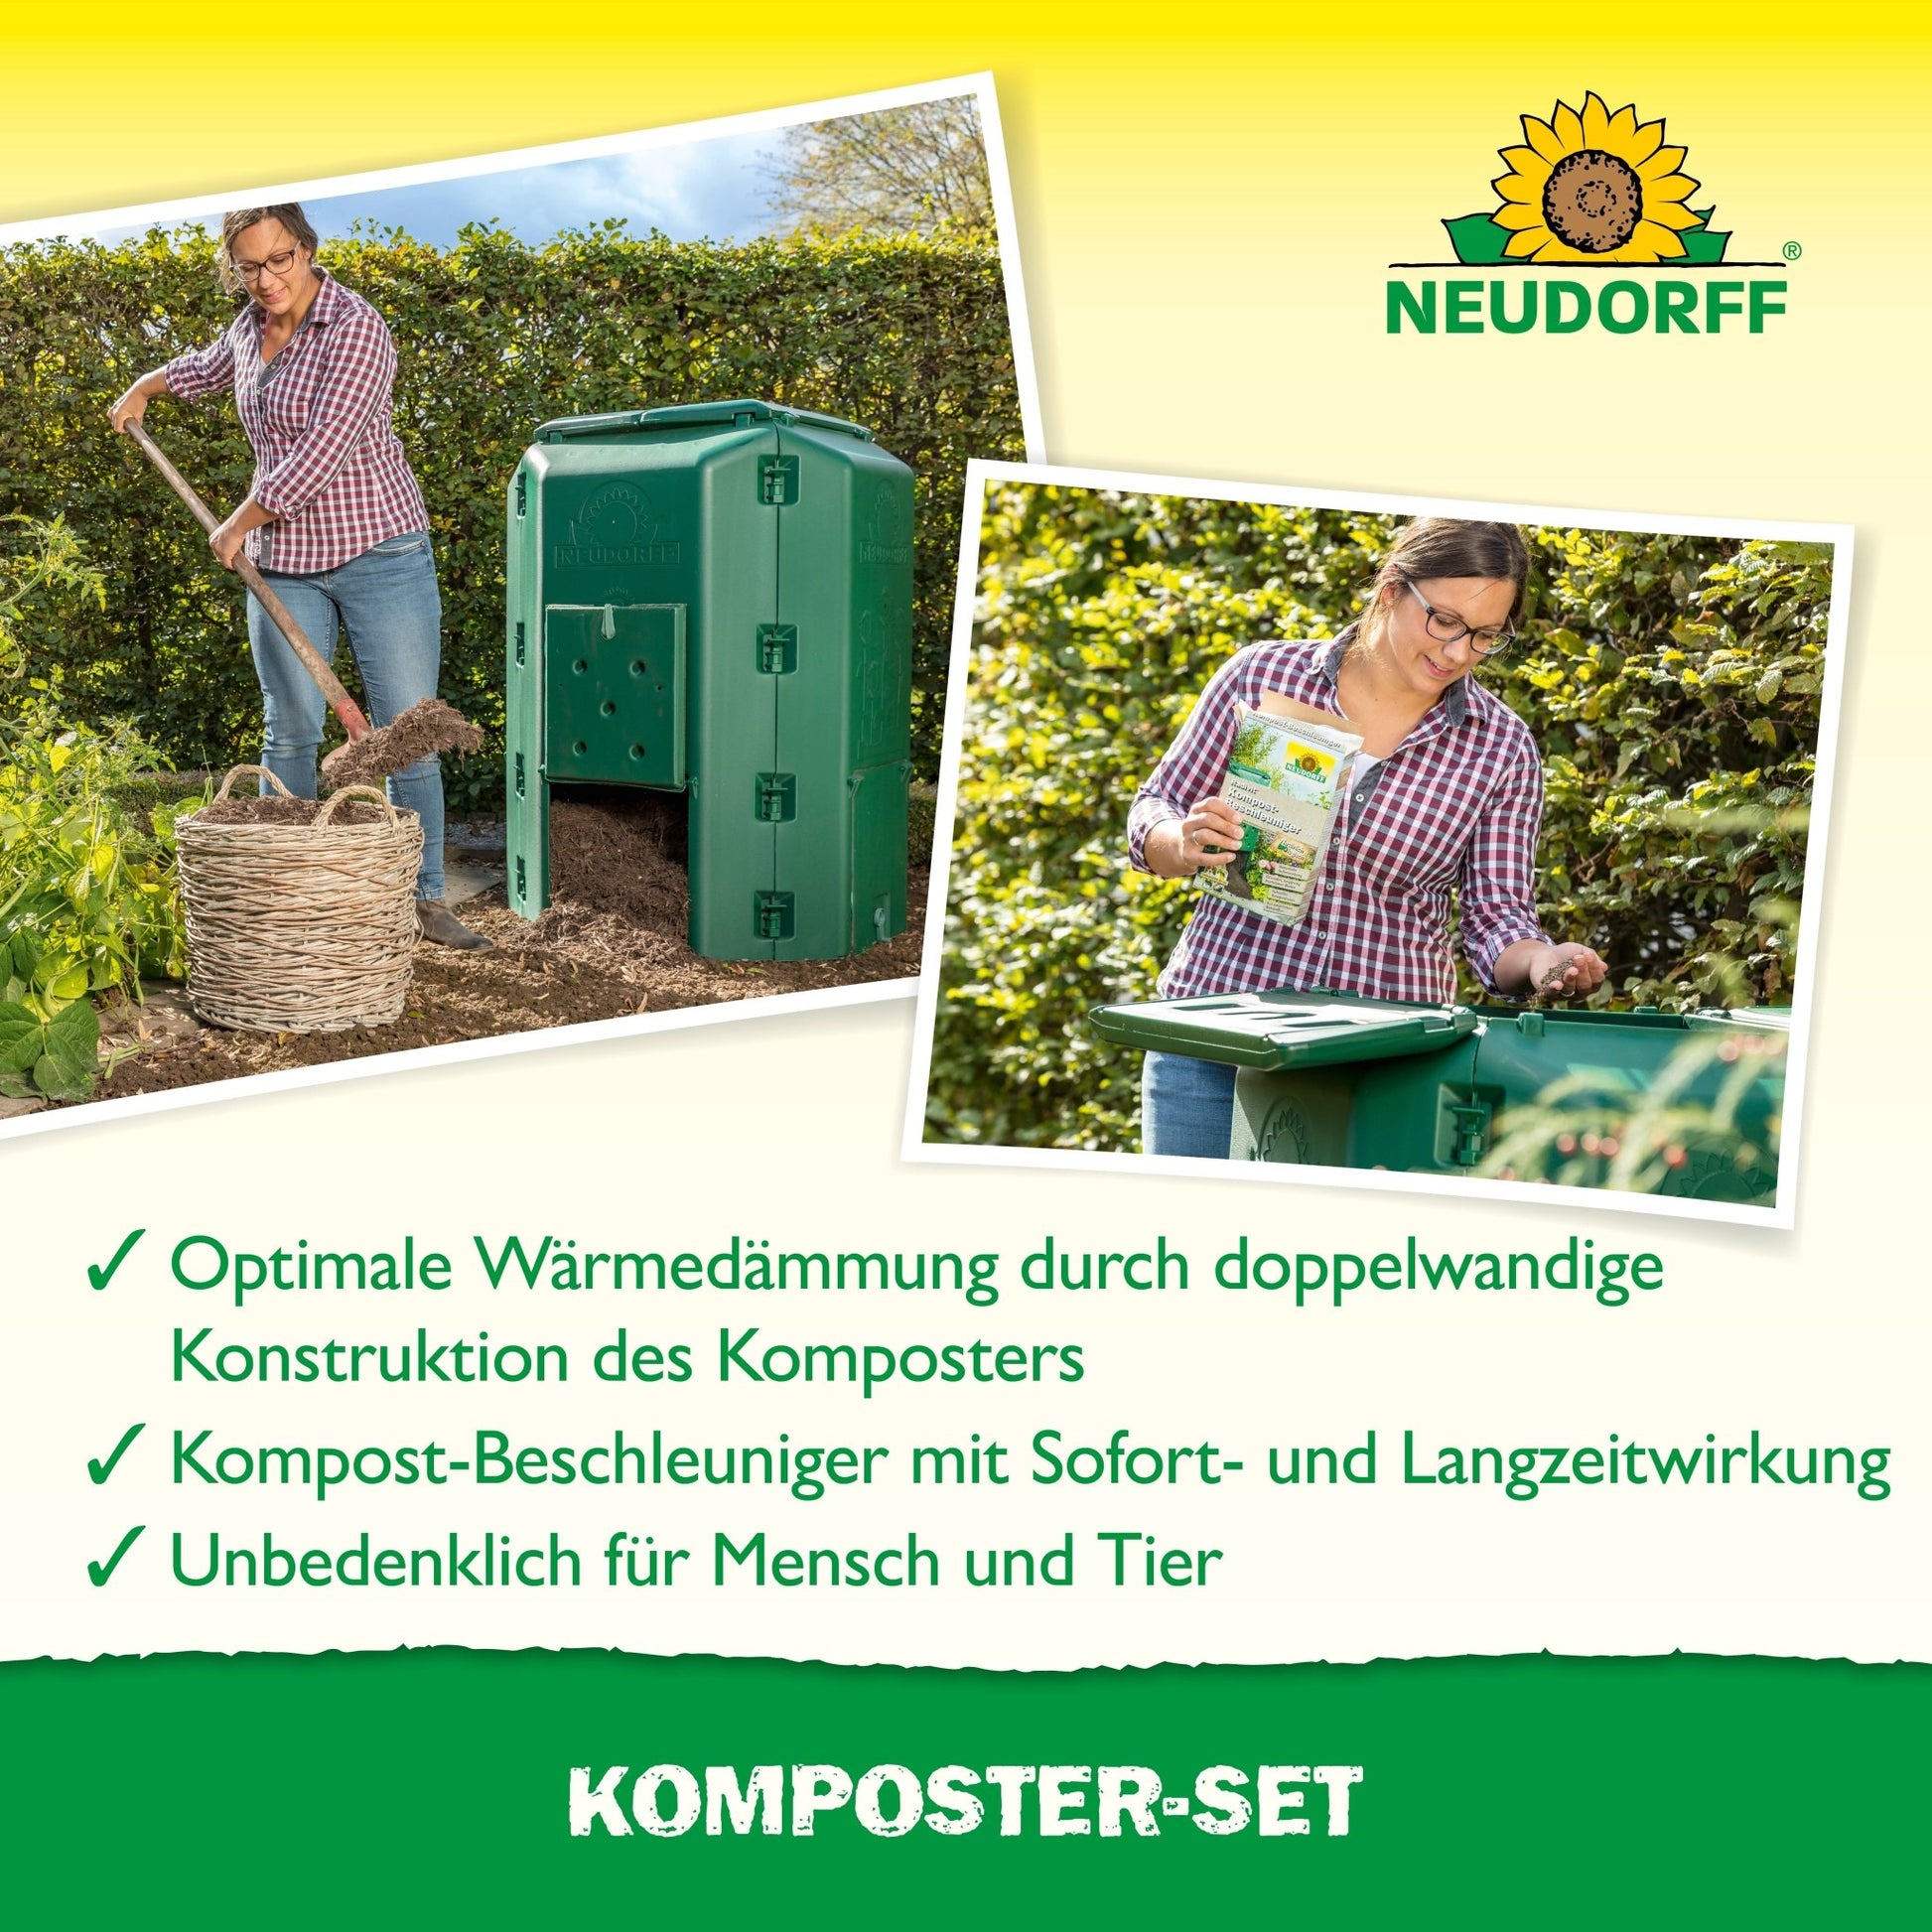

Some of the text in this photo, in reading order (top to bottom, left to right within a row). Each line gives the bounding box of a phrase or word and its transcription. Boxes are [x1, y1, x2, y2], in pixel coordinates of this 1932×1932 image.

[559, 544, 679, 566] NEUDORFF
[1285, 762, 1327, 783] NEUDORFF
[1227, 787, 1281, 815] Kompost-
[1225, 797, 1303, 836] Beschleuniger
